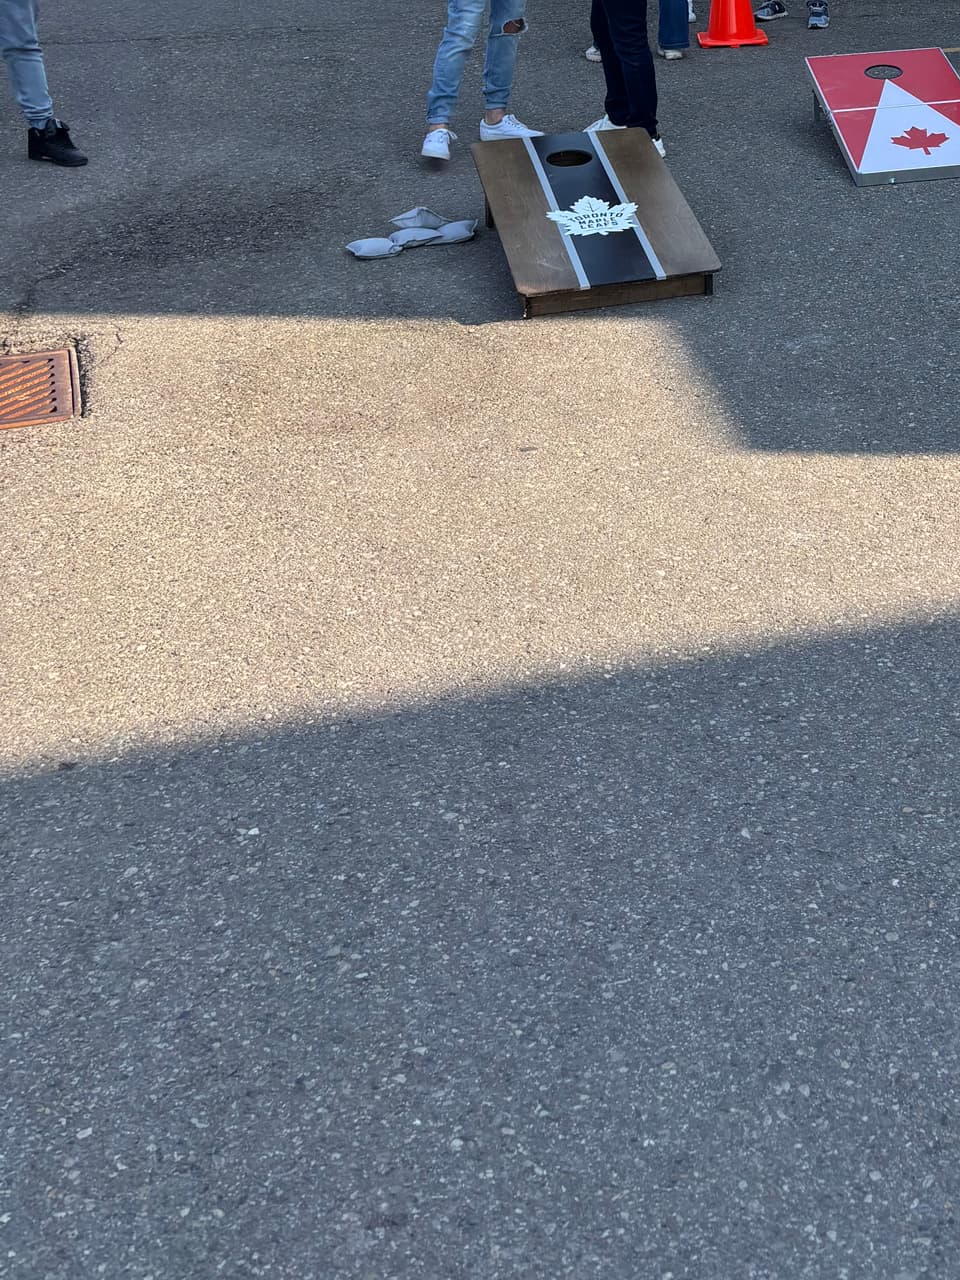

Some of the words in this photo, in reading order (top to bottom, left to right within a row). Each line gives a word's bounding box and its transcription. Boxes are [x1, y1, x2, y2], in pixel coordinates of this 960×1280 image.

[568, 212, 624, 223] TORONTO
[578, 217, 618, 225] MAPLE
[580, 221, 619, 230] LEAFS
